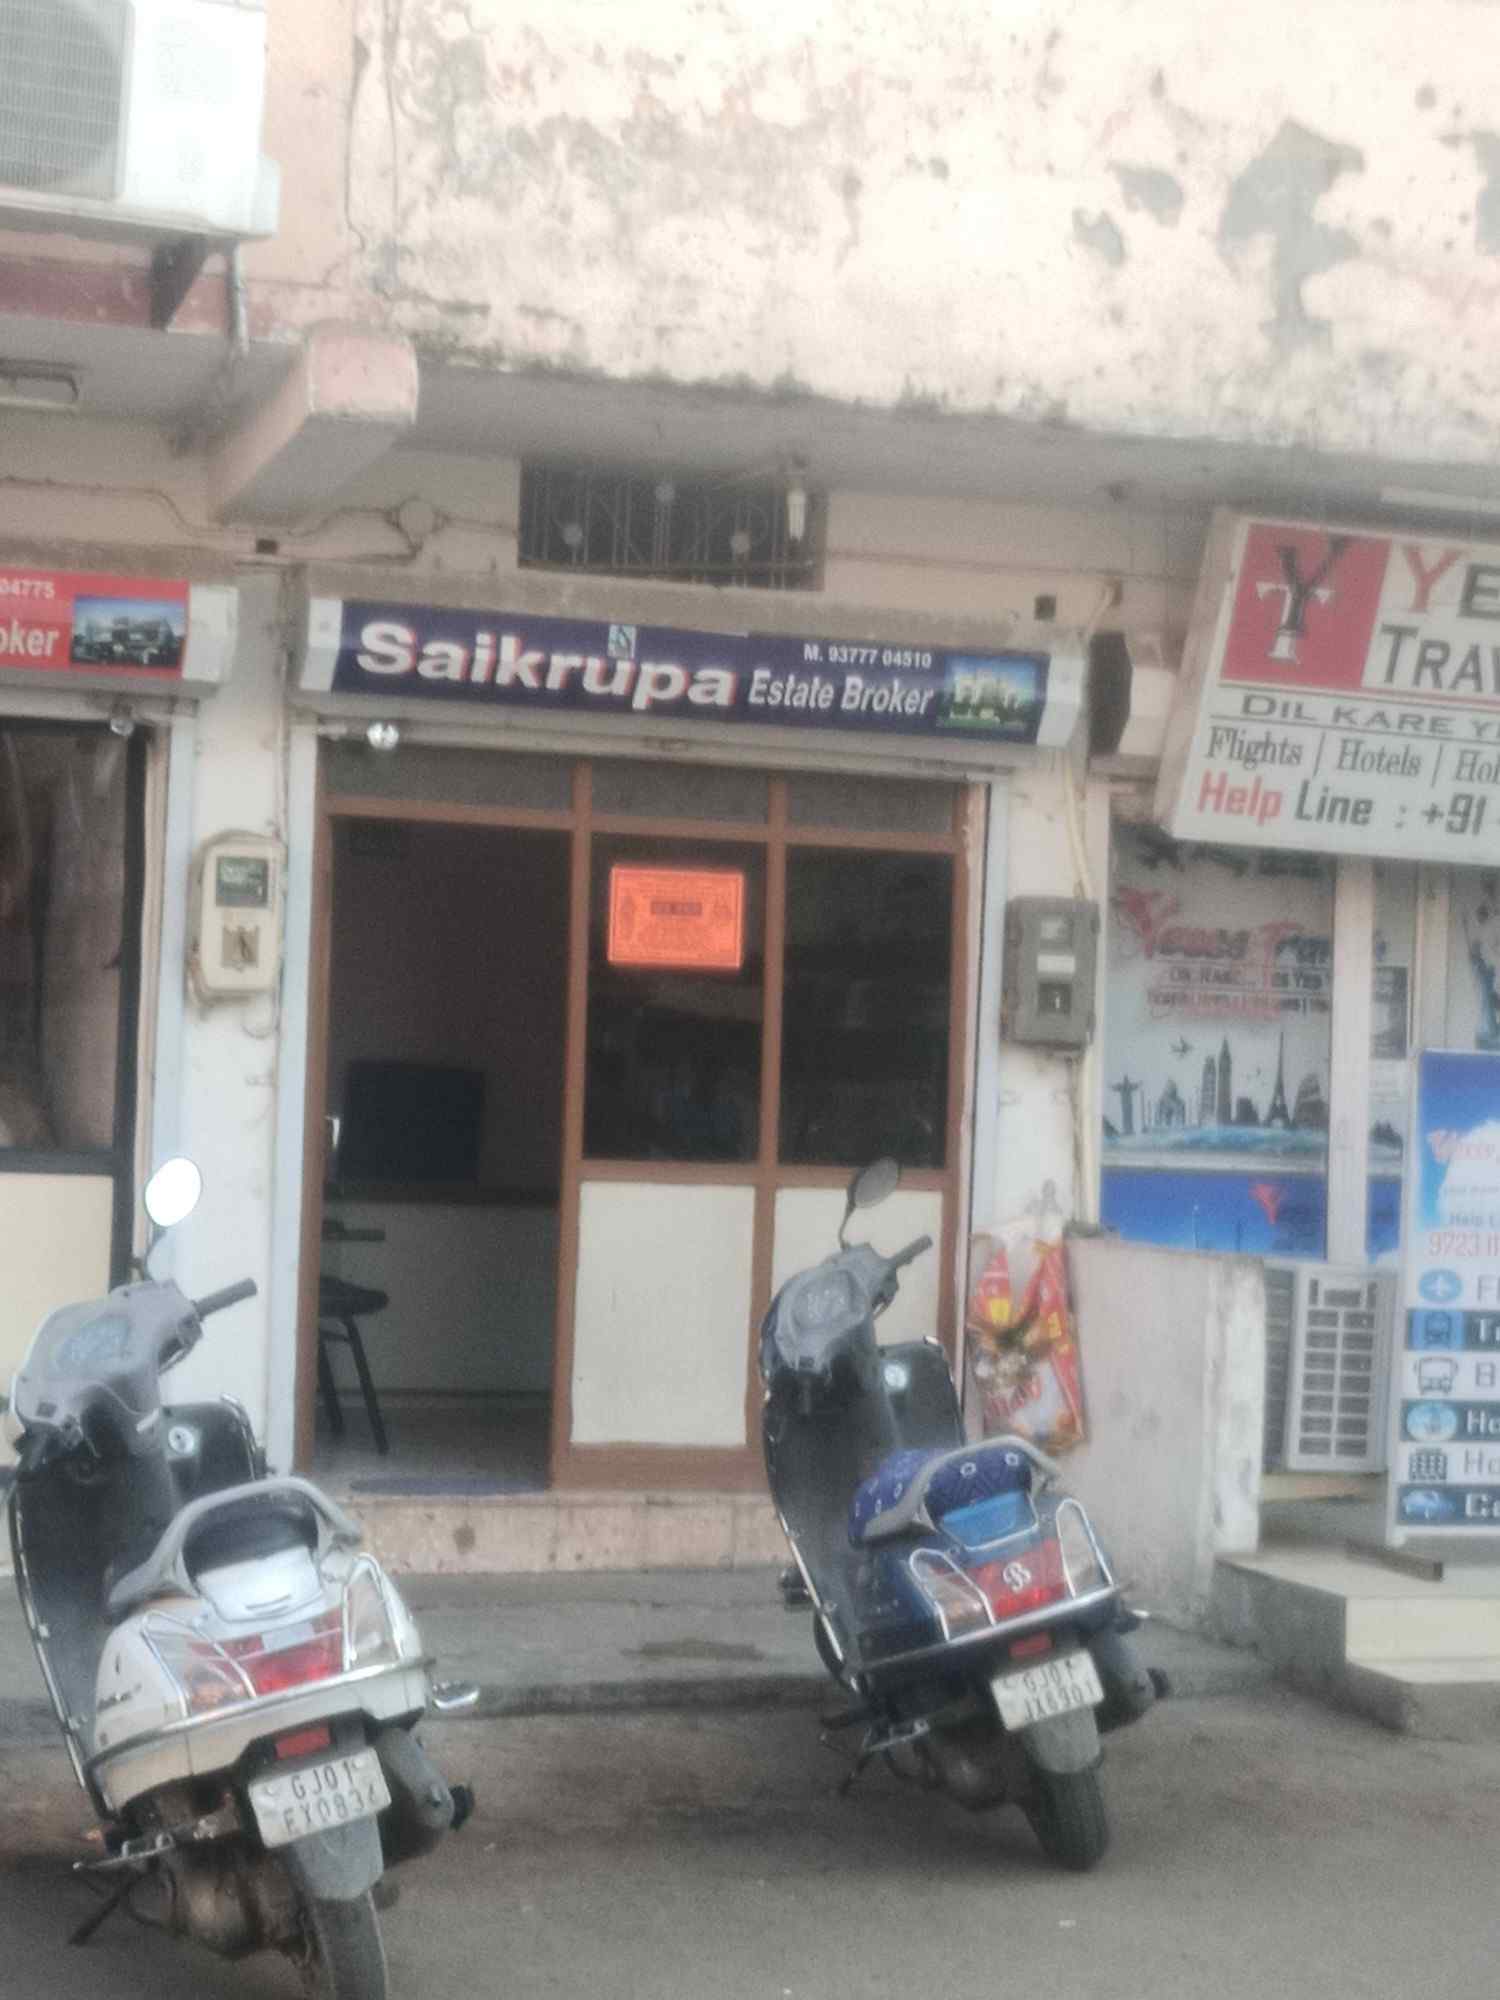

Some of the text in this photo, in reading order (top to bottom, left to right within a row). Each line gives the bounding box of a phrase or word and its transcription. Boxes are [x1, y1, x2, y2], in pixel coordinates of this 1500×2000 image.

[357, 620, 737, 710] Saikrupa
[748, 669, 934, 715] Estate Broker
[1241, 694, 1500, 739] DIL KARE Y
[1204, 725, 1304, 770] Flights
[1337, 737, 1422, 778] Hotels
[1196, 769, 1283, 827] Help
[1295, 778, 1374, 827] Line
[291, 1760, 354, 1800] GJ01
